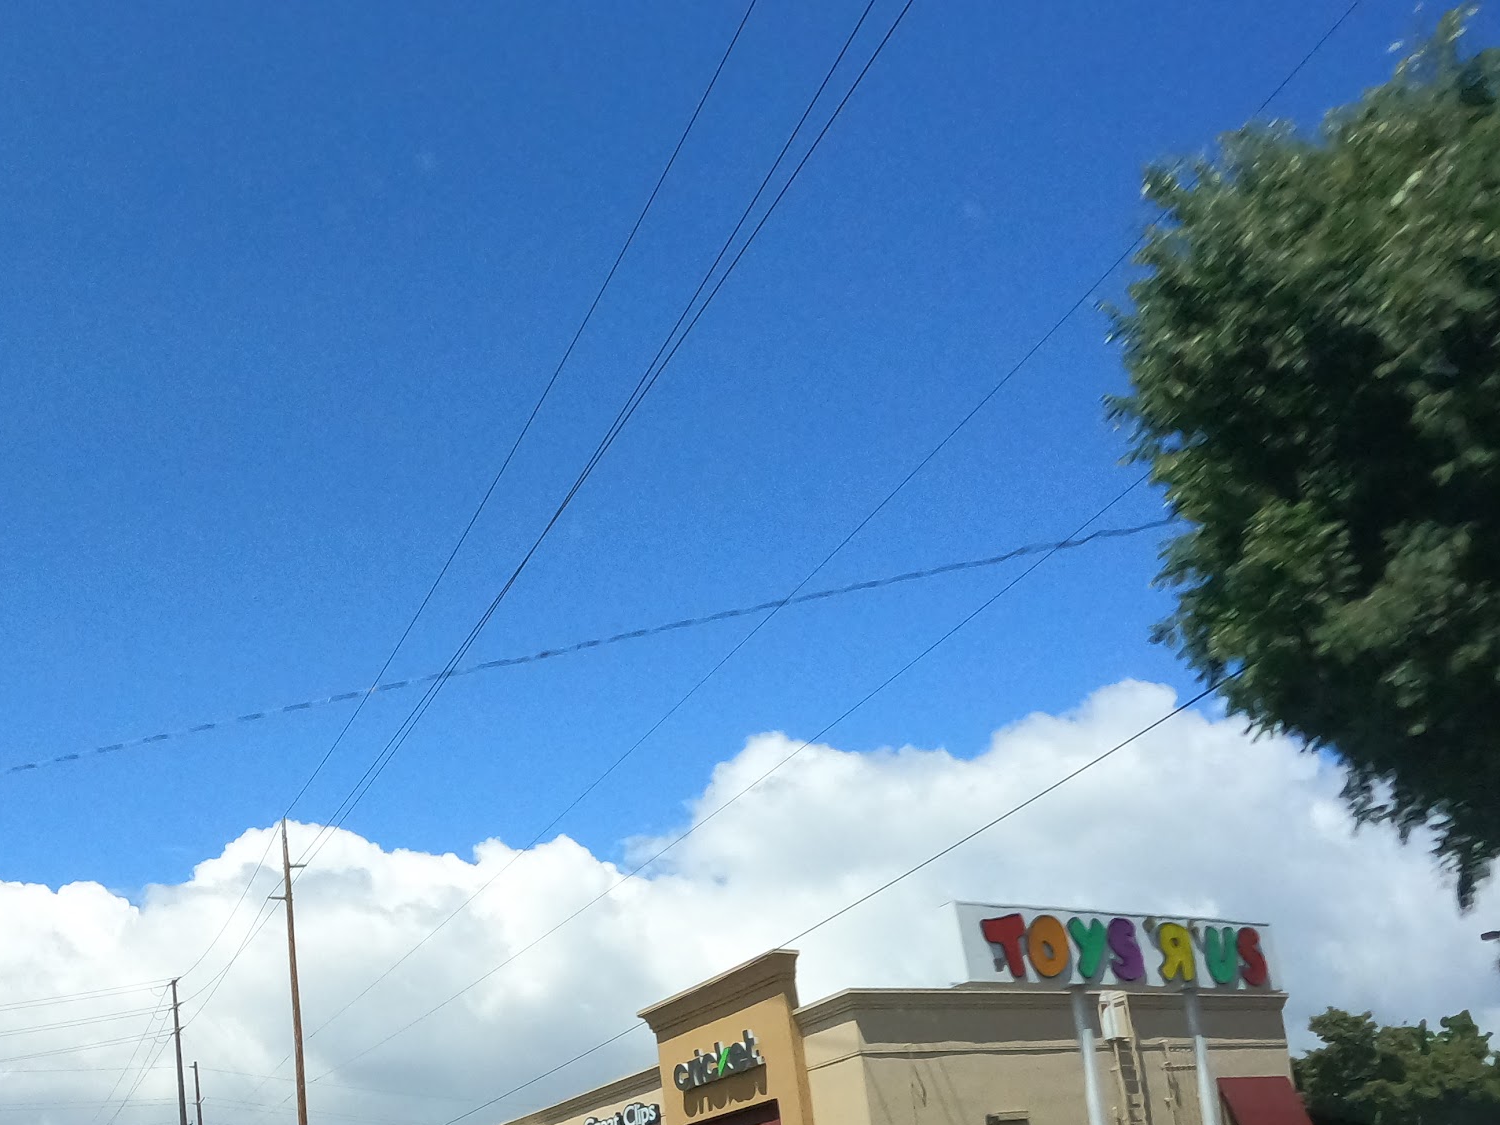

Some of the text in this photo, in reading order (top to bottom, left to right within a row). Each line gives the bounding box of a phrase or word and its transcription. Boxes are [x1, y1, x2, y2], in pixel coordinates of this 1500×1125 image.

[980, 913, 1145, 981] TOYS
[1204, 925, 1268, 986] US
[673, 1029, 760, 1092] cricket
